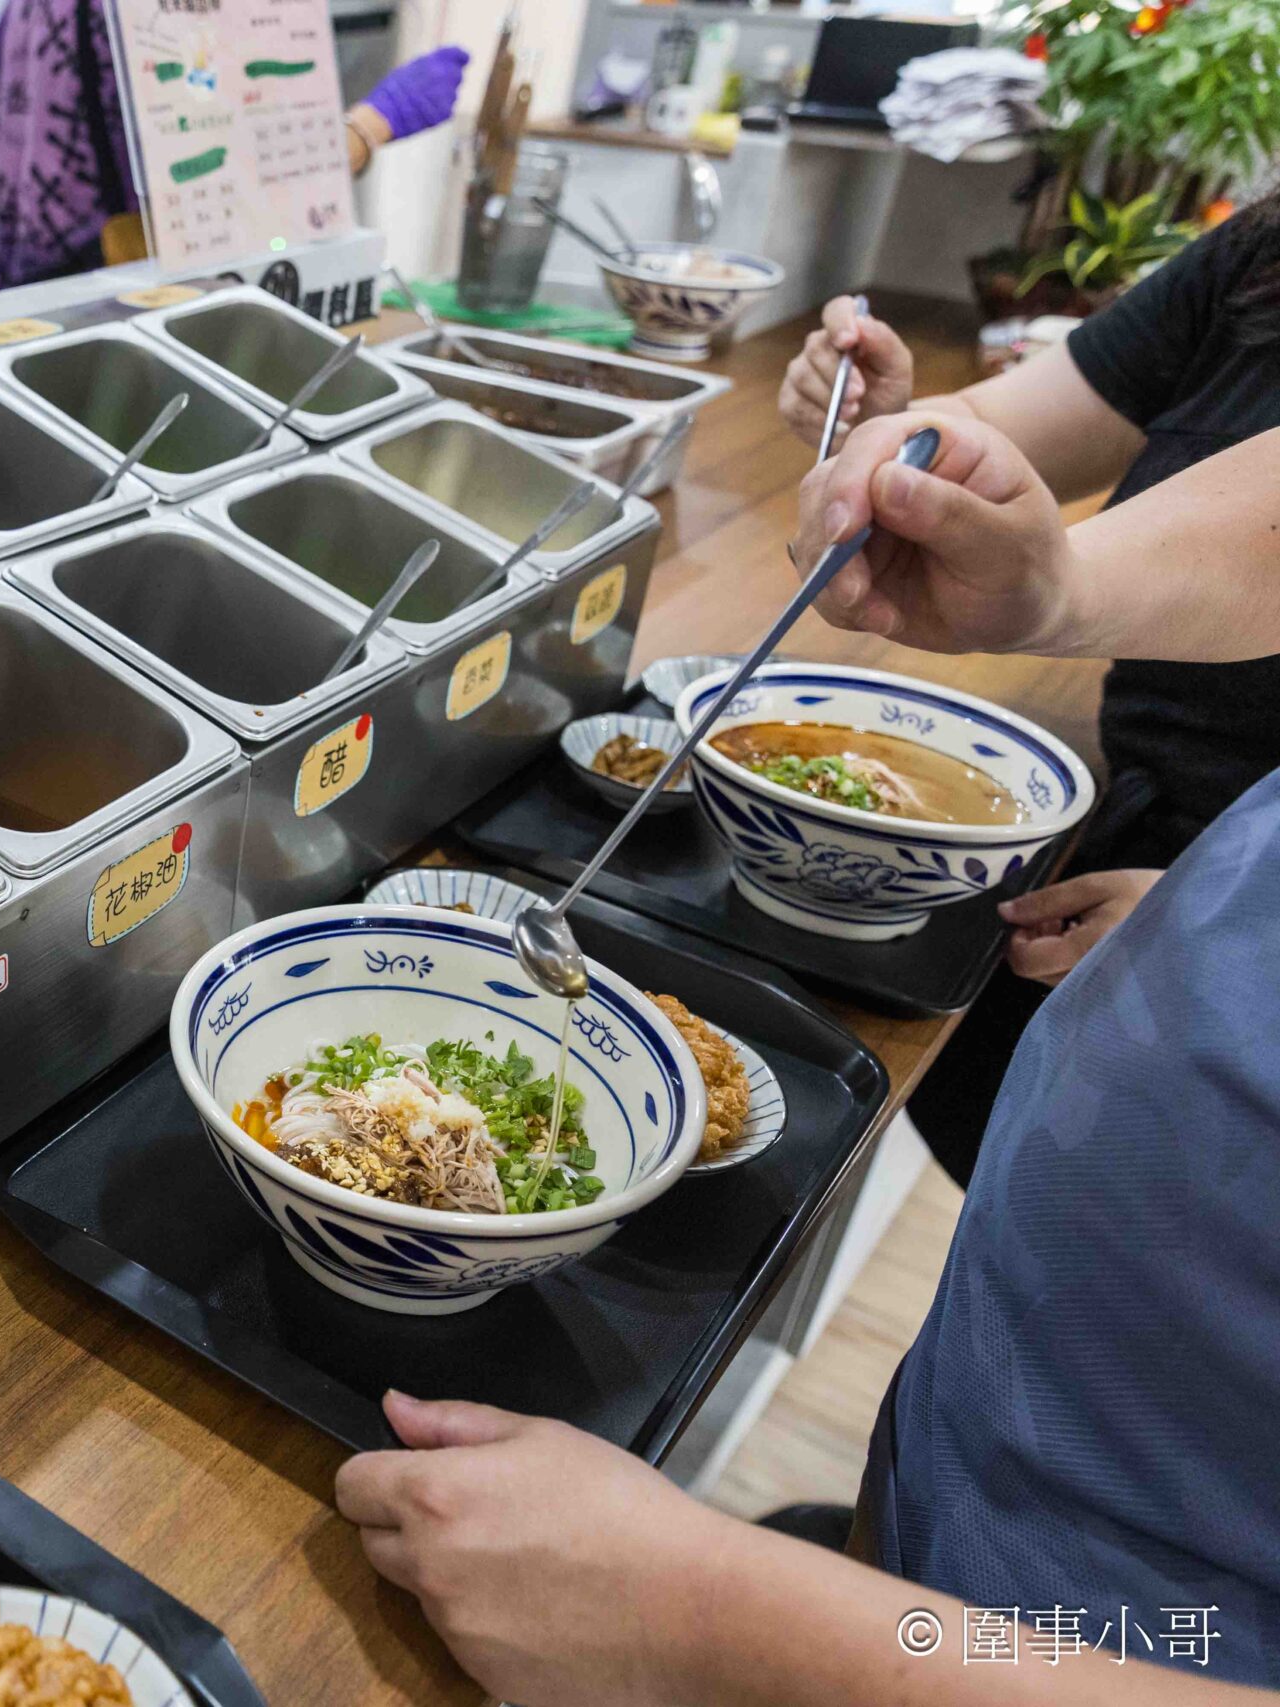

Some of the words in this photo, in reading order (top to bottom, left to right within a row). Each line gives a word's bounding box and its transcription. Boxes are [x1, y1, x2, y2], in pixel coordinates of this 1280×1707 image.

[320, 740, 348, 788] 醋
[104, 854, 178, 922] 花椒油
